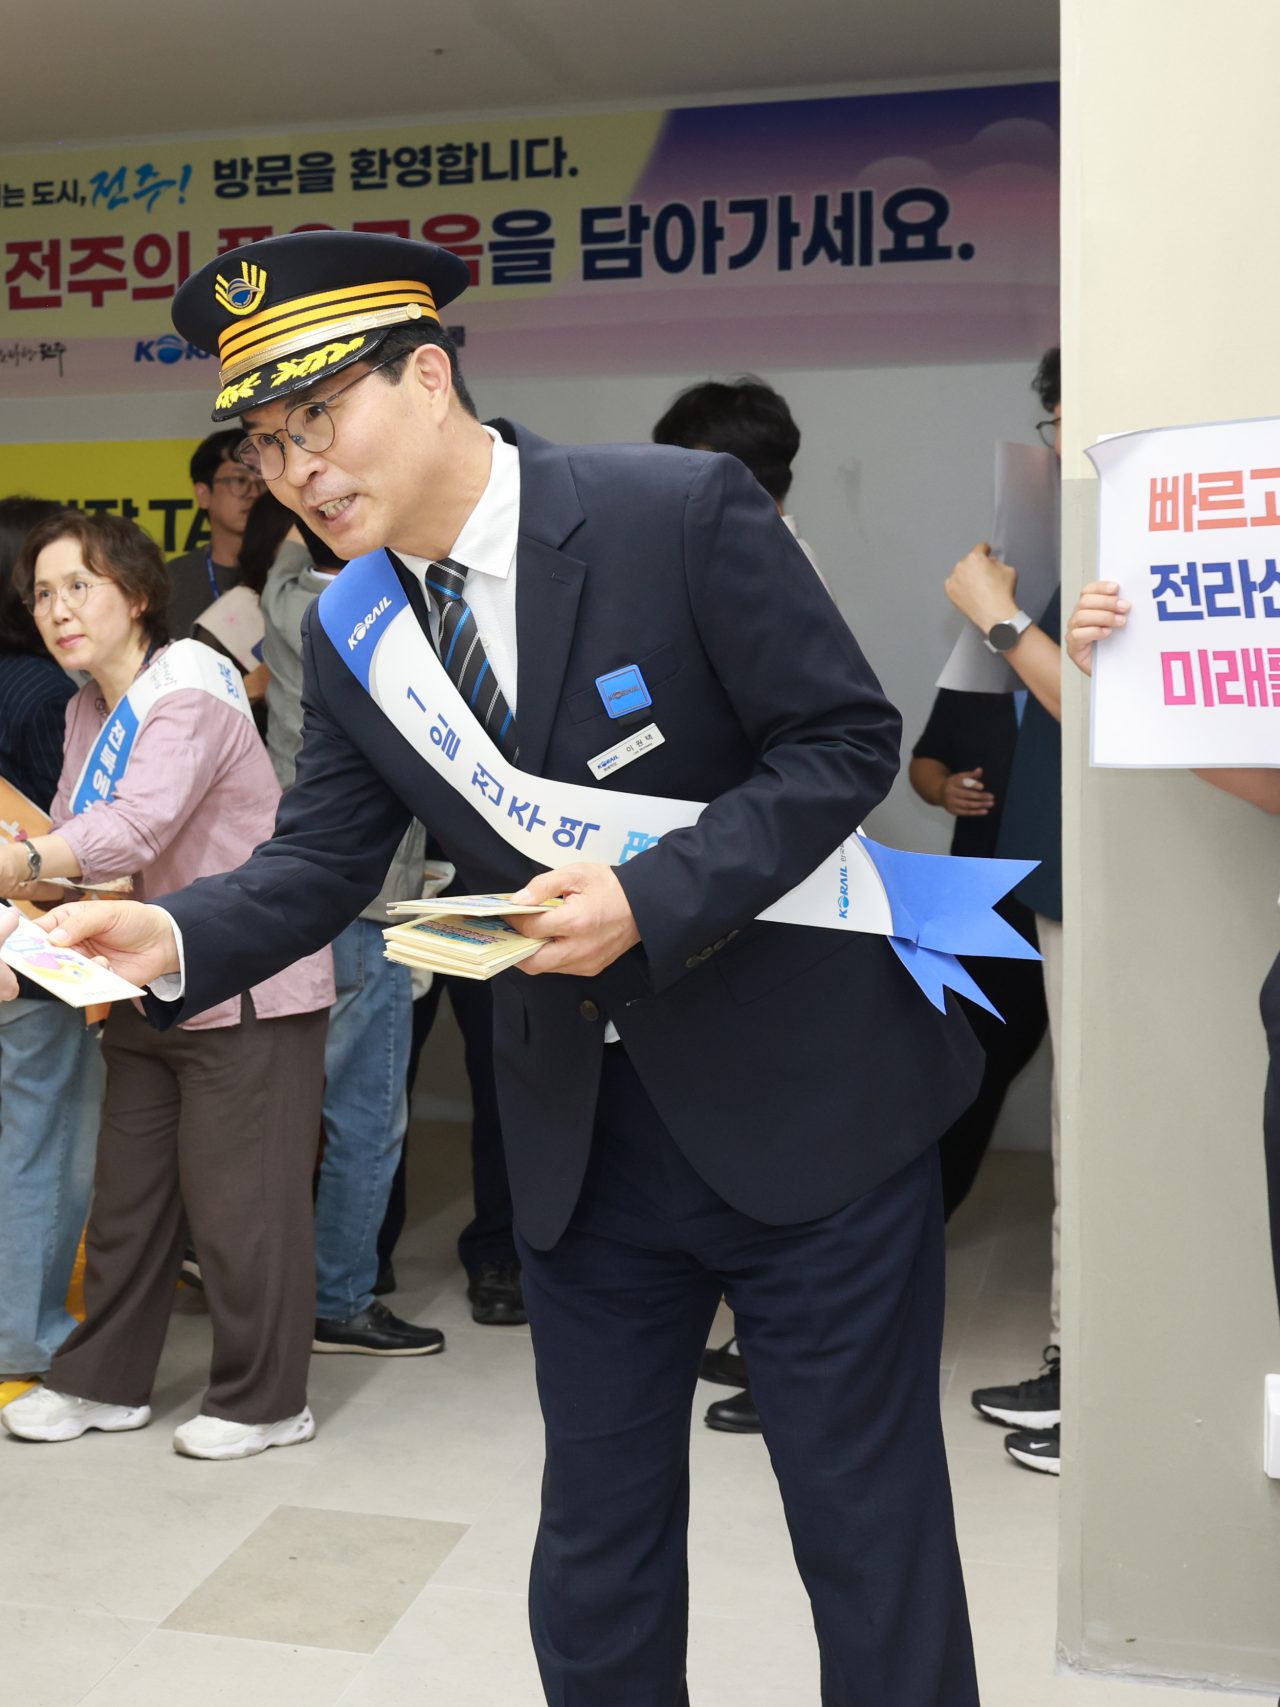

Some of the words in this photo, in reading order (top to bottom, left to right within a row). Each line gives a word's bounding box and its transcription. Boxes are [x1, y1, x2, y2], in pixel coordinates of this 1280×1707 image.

[32, 179, 87, 208] 도시,
[89, 163, 193, 214] 전주!
[214, 151, 336, 199] 방문을
[350, 136, 579, 190] 환영합니다.
[5, 230, 191, 311] 전주의
[580, 186, 976, 281] 담아가세요.
[148, 499, 212, 552] TA
[1148, 467, 1280, 533] 빠르고
[348, 596, 392, 651] KORAIL
[406, 686, 462, 761] 1일
[471, 761, 601, 851] 전주역
[838, 866, 850, 919] KORAIL
